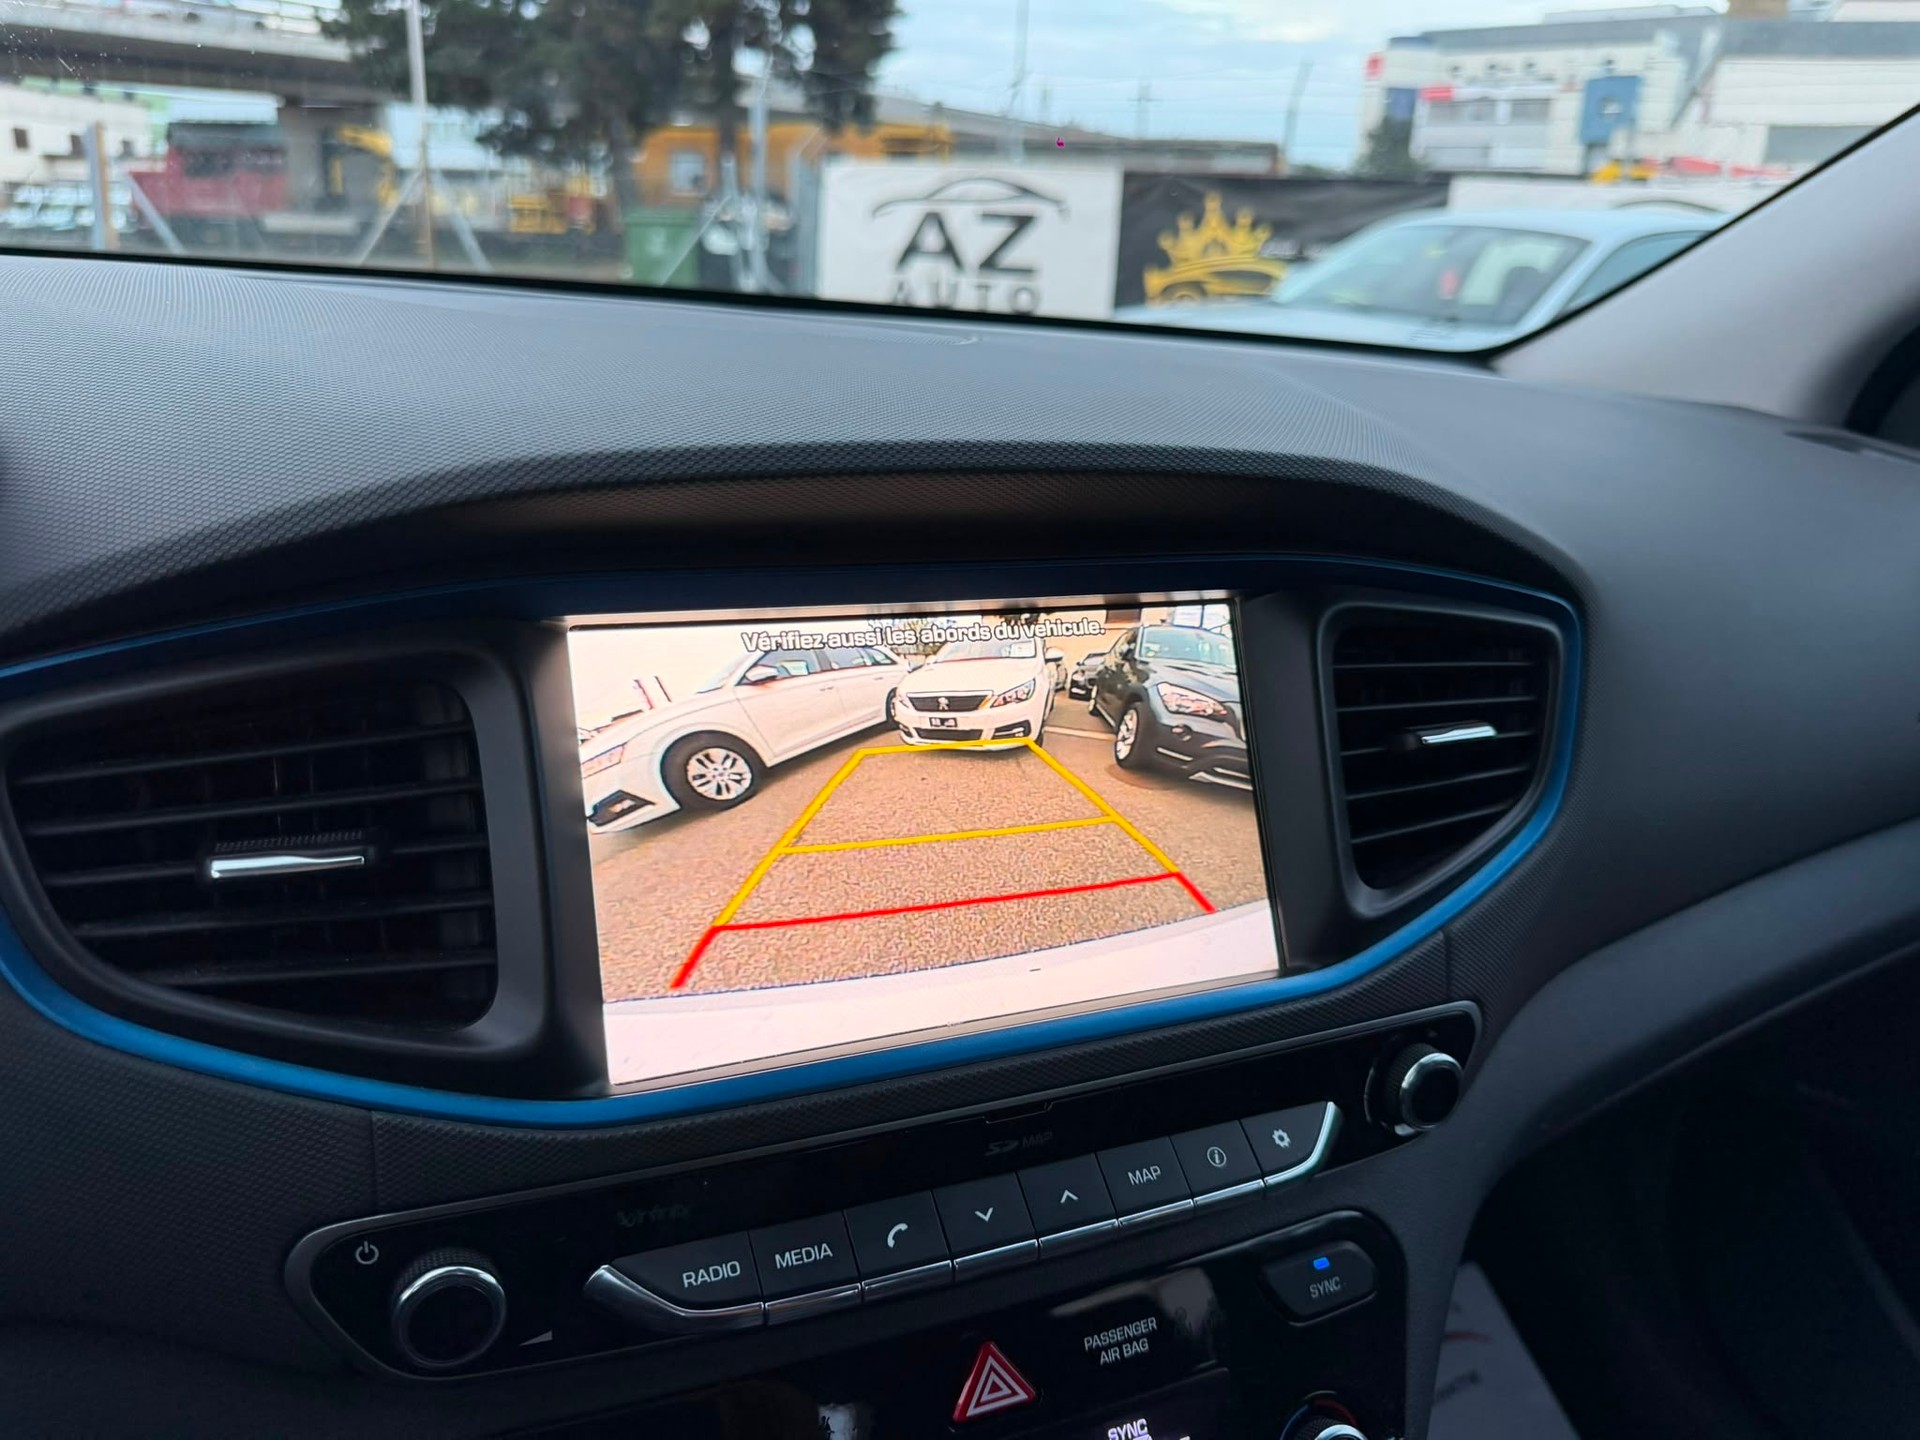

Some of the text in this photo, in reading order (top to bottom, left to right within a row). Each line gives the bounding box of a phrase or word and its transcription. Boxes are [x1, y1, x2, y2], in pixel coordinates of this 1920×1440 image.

[897, 211, 1037, 273] AZ
[893, 281, 1040, 315] AUTO
[741, 630, 825, 652] Vérifiez
[827, 628, 882, 648] aussi
[886, 626, 917, 645] les
[920, 623, 991, 644] abords
[994, 622, 1020, 640] du
[1127, 1165, 1162, 1186] MAP
[774, 1243, 833, 1270] MEDIA
[682, 1260, 741, 1288] RADIO
[1309, 1276, 1342, 1298] SYNC
[1084, 1316, 1158, 1351] PASSENGER
[1100, 1337, 1149, 1365] AIR BAG
[1108, 1418, 1148, 1440] SYNC
